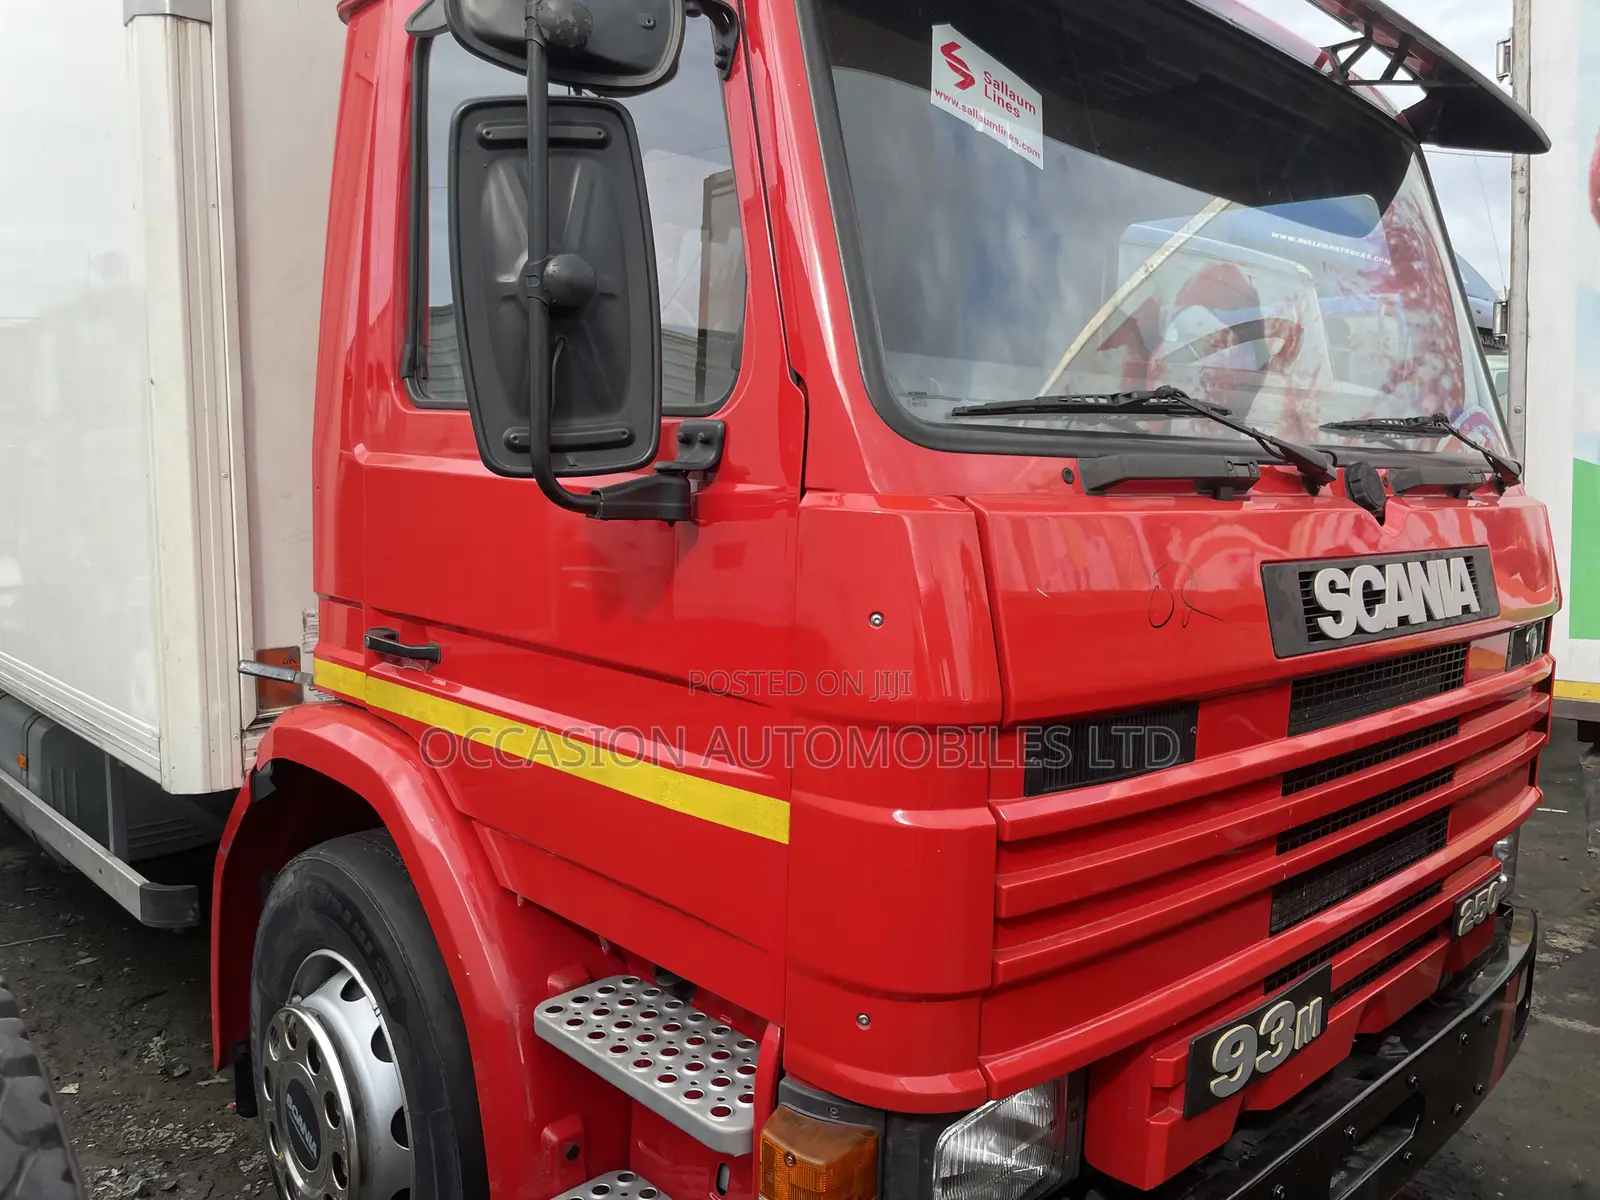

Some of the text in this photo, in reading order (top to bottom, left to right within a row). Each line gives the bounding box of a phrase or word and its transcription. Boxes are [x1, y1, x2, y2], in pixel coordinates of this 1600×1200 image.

[934, 88, 1041, 160] www.sallaumlines.com
[983, 71, 1037, 116] Sallaum
[983, 84, 1021, 119] Lines
[1314, 557, 1480, 639] SCANIA
[1458, 881, 1500, 936] 250
[1209, 996, 1323, 1099] 93M
[286, 1093, 317, 1159] SCANIA
